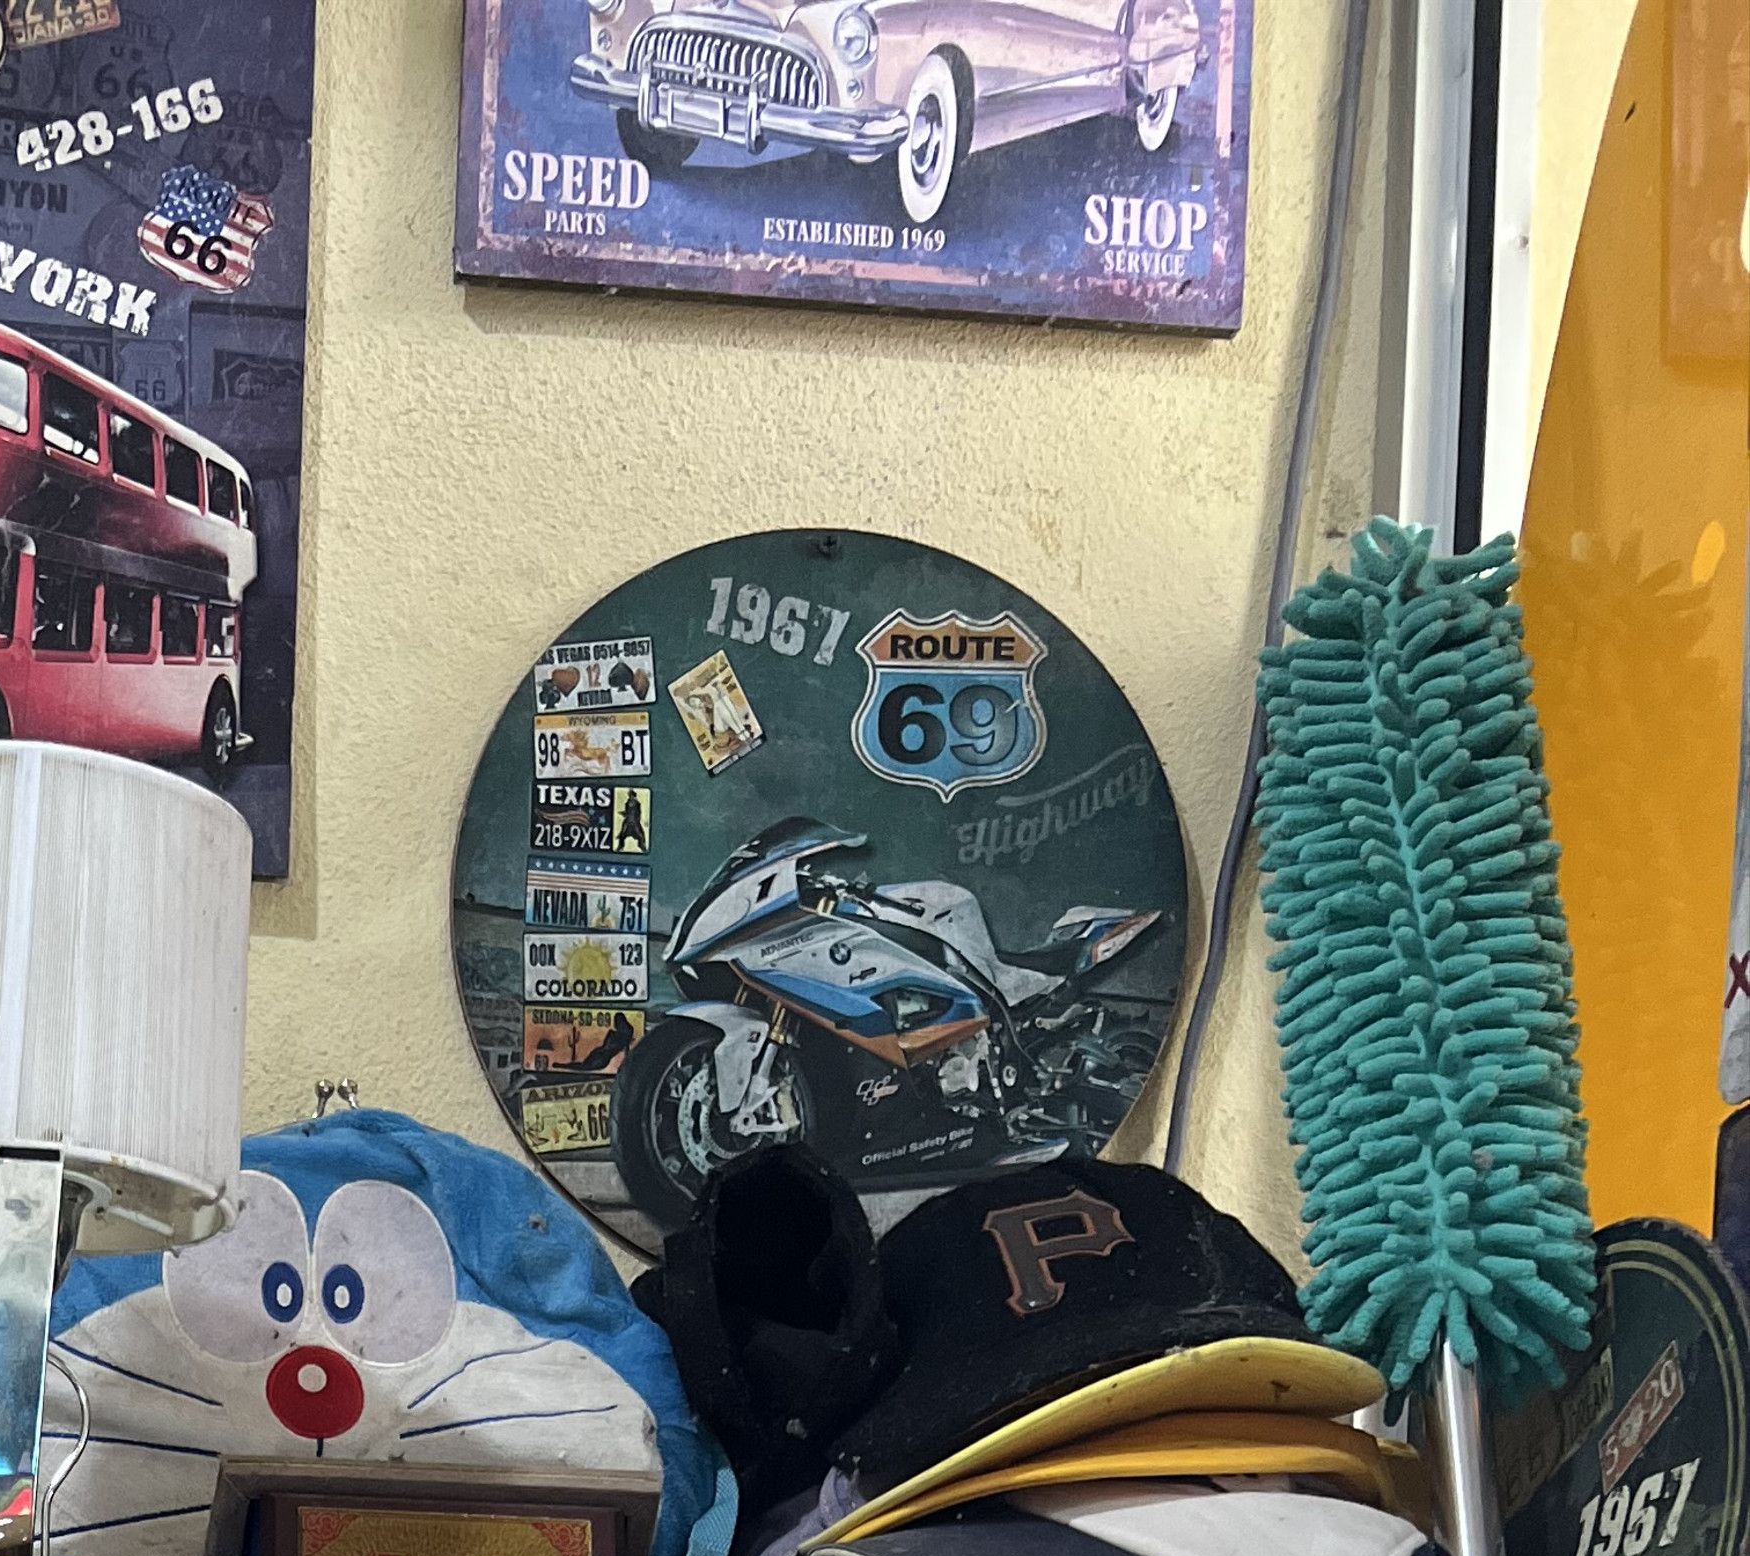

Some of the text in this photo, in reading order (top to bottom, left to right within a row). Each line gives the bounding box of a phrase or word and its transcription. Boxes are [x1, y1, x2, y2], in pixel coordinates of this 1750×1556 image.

[17, 78, 223, 171] 428-166
[503, 149, 649, 210] SPEED
[544, 210, 607, 237] PARTS
[762, 218, 946, 251] ESTABLISHED 1969
[1084, 194, 1207, 251] SHOP
[164, 220, 233, 275] 66
[1103, 247, 1187, 277] SERVICE
[705, 577, 850, 667] 1967
[556, 646, 590, 663] VEGAS
[890, 634, 1016, 661] ROUTE
[568, 715, 616, 726] WYOMING
[878, 683, 1018, 766] 69
[538, 730, 648, 767] 98 BT
[536, 784, 611, 807] TEXAS
[533, 888, 643, 931] NEVADA 751
[619, 943, 643, 966] 123
[535, 979, 637, 997] COLORADO
[587, 1103, 610, 1141] 66
[862, 1145, 907, 1165] Official
[909, 1136, 947, 1152] Safety
[983, 1189, 1135, 1315] P
